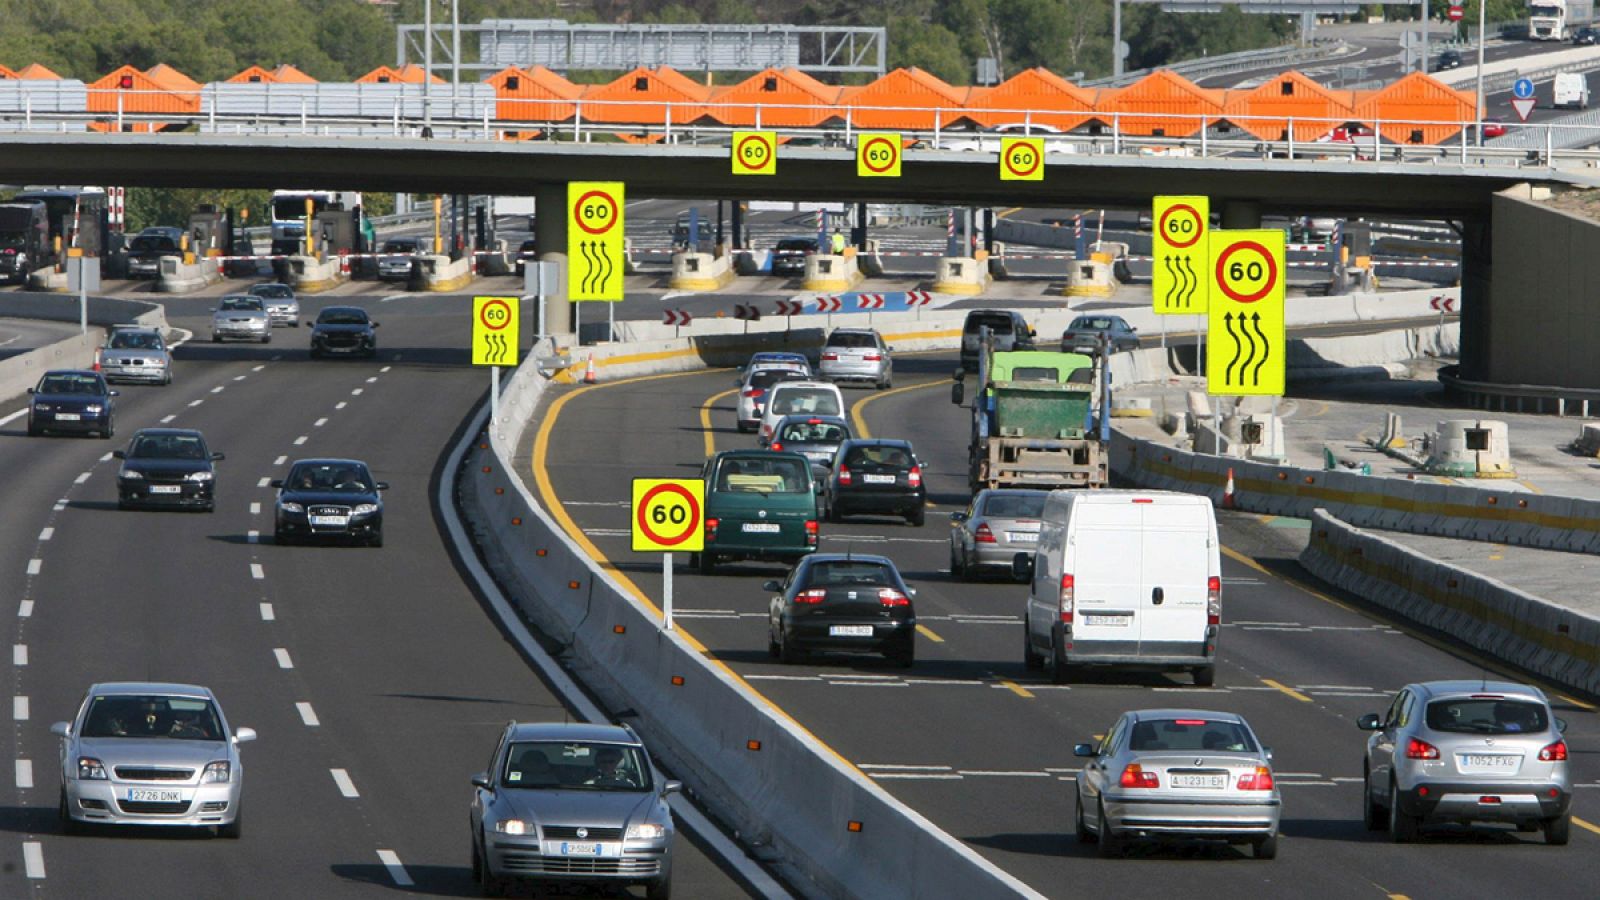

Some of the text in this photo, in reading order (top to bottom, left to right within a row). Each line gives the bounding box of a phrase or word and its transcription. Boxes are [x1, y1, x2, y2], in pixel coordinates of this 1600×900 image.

[745, 147, 764, 158] 60
[870, 150, 889, 161] 60
[1013, 153, 1032, 165] 60
[585, 204, 608, 218] 60
[1168, 219, 1193, 233] 60
[1230, 261, 1263, 282] 60
[487, 310, 504, 320] 60
[652, 504, 686, 524] 60
[1470, 755, 1514, 766] 1052 FXG
[1184, 776, 1206, 785] 1231
[1211, 776, 1223, 786] EH
[134, 791, 179, 801] 2726 DNK
